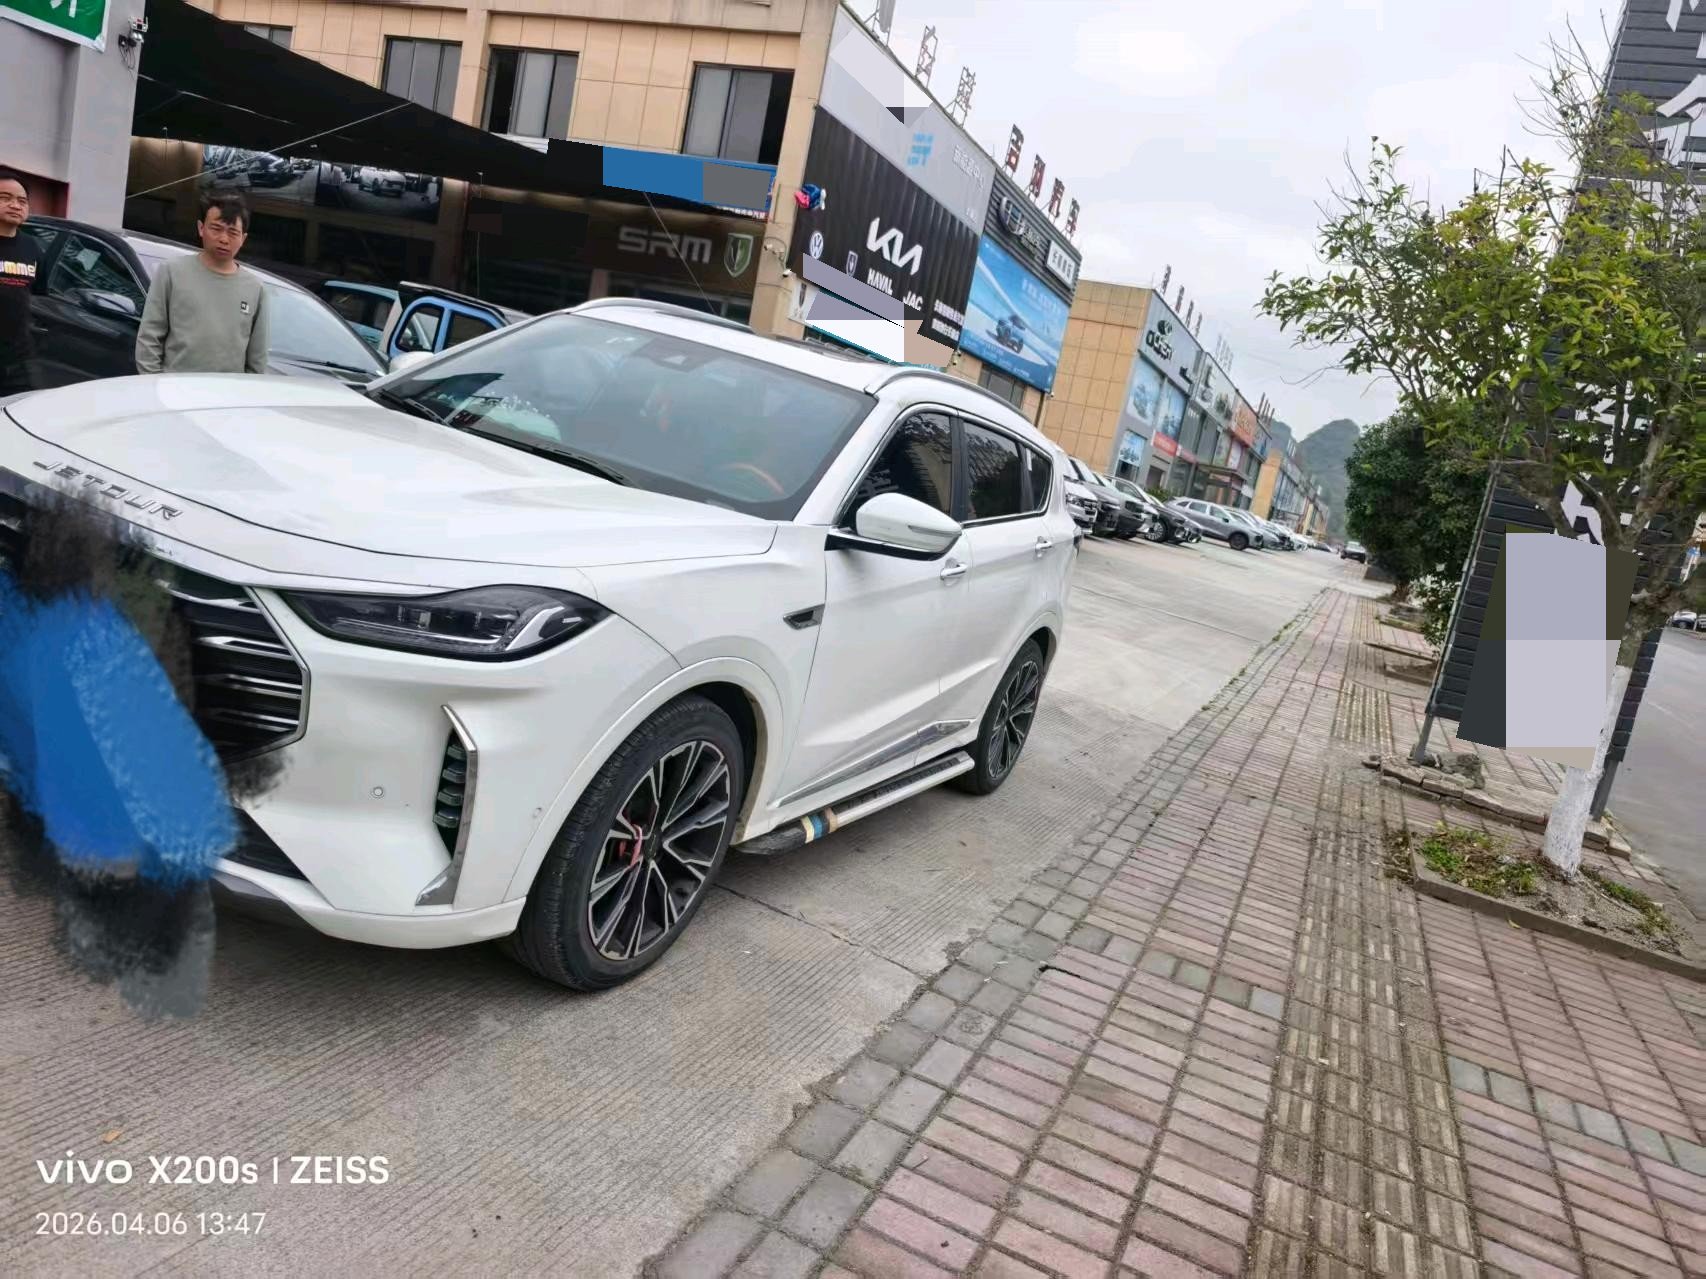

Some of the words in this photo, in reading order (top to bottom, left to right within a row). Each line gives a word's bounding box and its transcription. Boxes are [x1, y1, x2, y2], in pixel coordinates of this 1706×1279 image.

[867, 267, 894, 295] HAVAL
[902, 290, 924, 312] JAC
[33, 460, 184, 521] JETOUR
